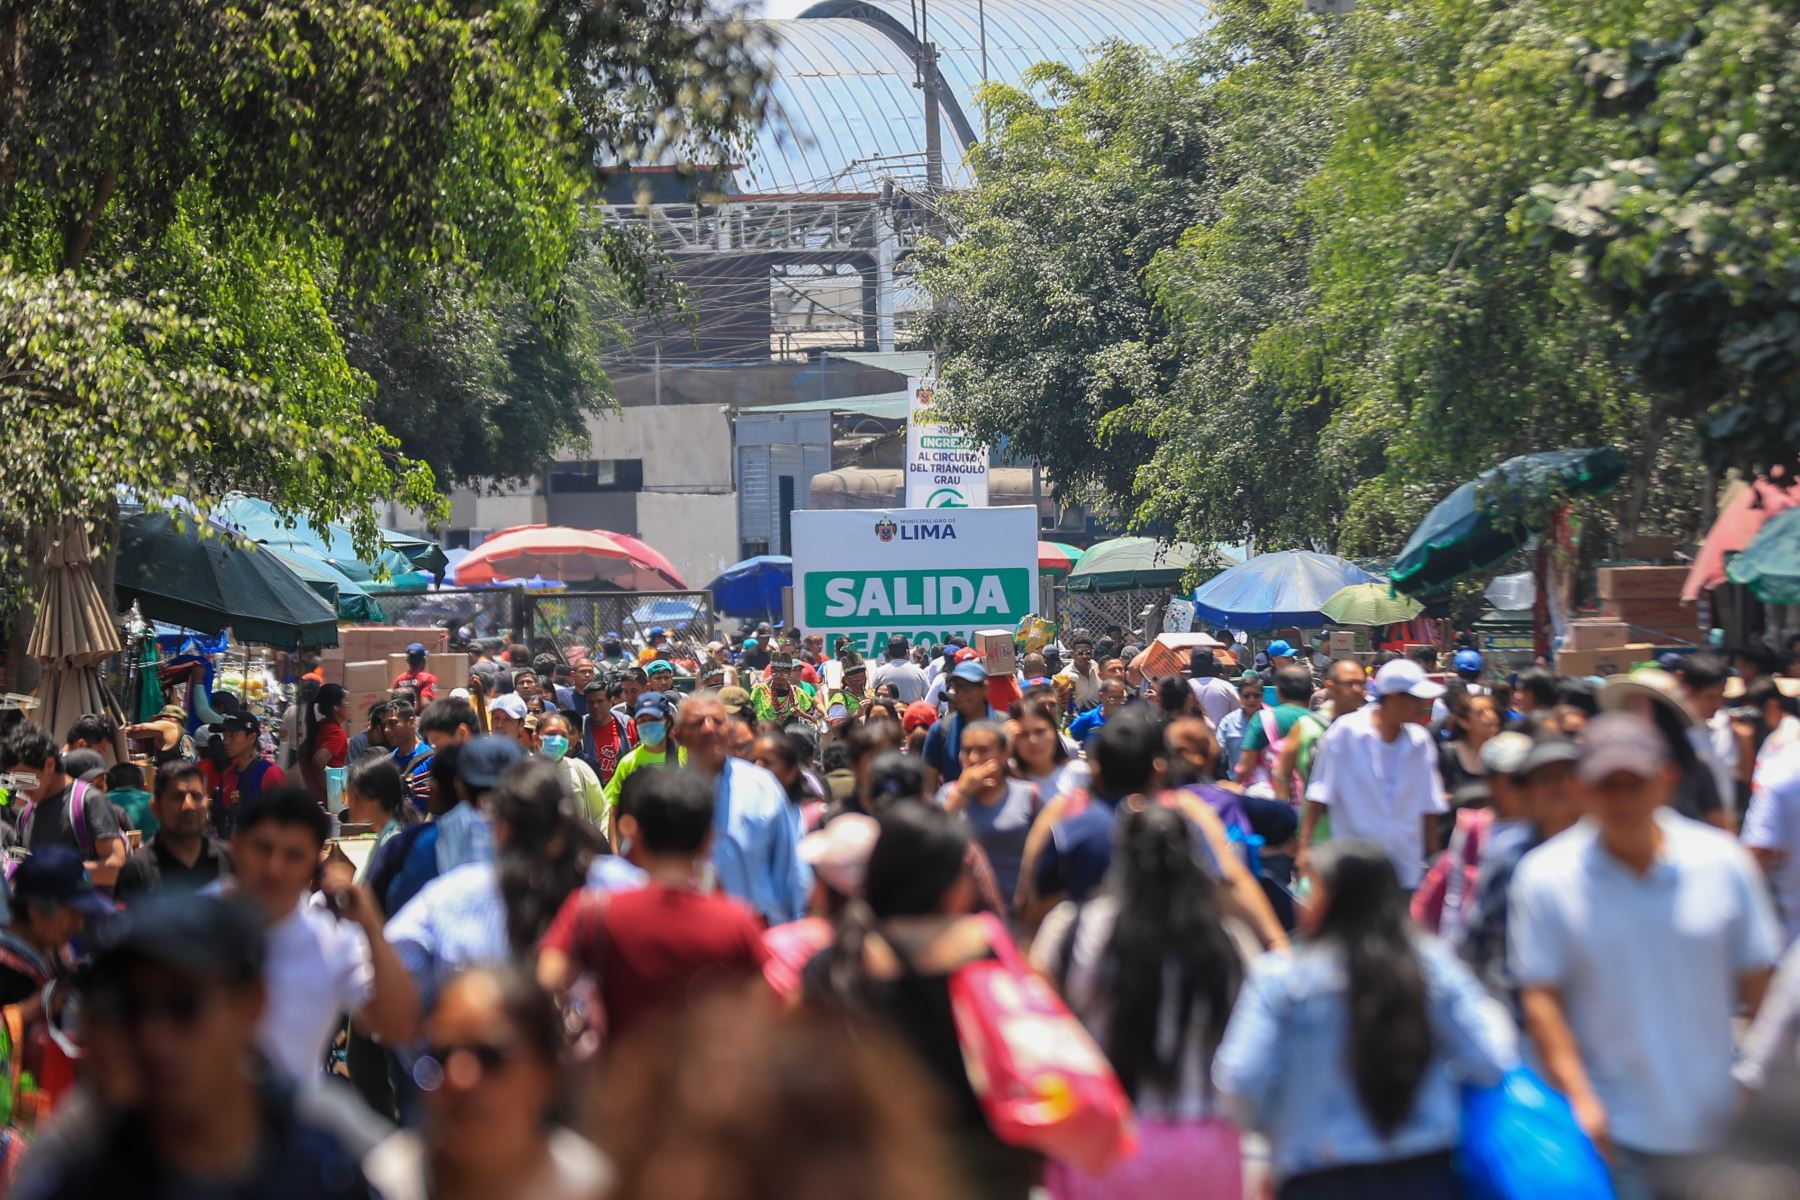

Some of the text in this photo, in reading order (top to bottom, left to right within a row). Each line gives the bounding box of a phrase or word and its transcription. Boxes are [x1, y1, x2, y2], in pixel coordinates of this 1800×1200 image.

[923, 437, 973, 448] INGREO
[918, 451, 930, 461] AL
[910, 463, 928, 473] DEL
[934, 475, 961, 485] GRAU
[901, 524, 957, 540] LIMA
[825, 575, 1010, 617] SALIDA
